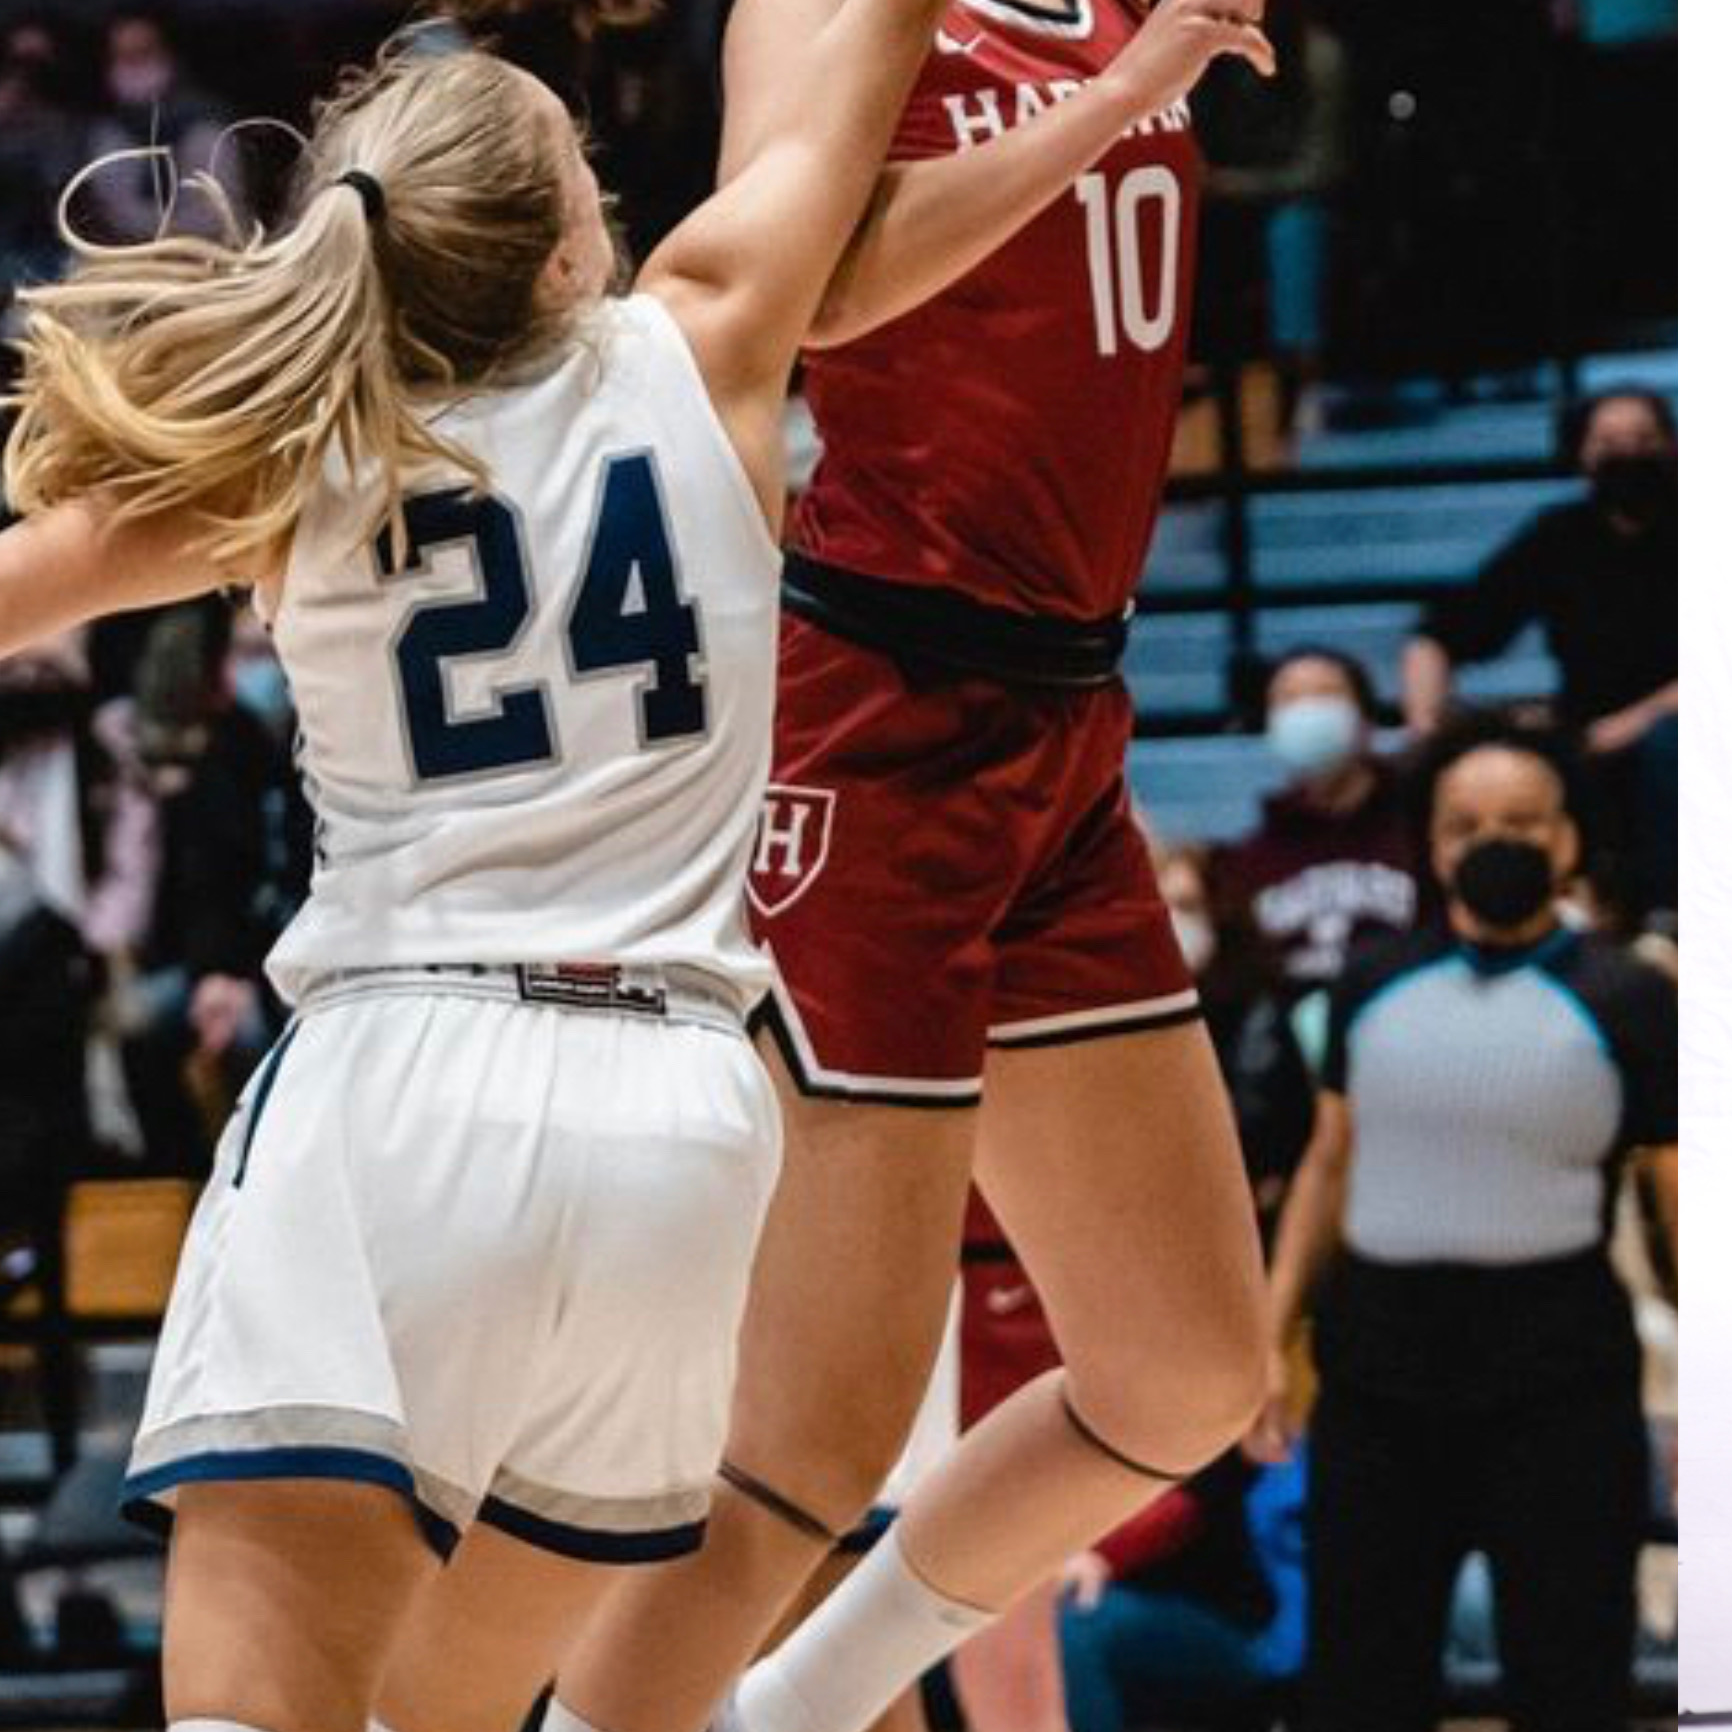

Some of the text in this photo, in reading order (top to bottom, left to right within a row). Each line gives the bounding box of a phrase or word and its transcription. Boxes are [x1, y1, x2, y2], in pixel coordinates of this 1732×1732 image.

[1074, 164, 1182, 357] 10
[374, 446, 711, 790] 24
[753, 800, 811, 876] H
